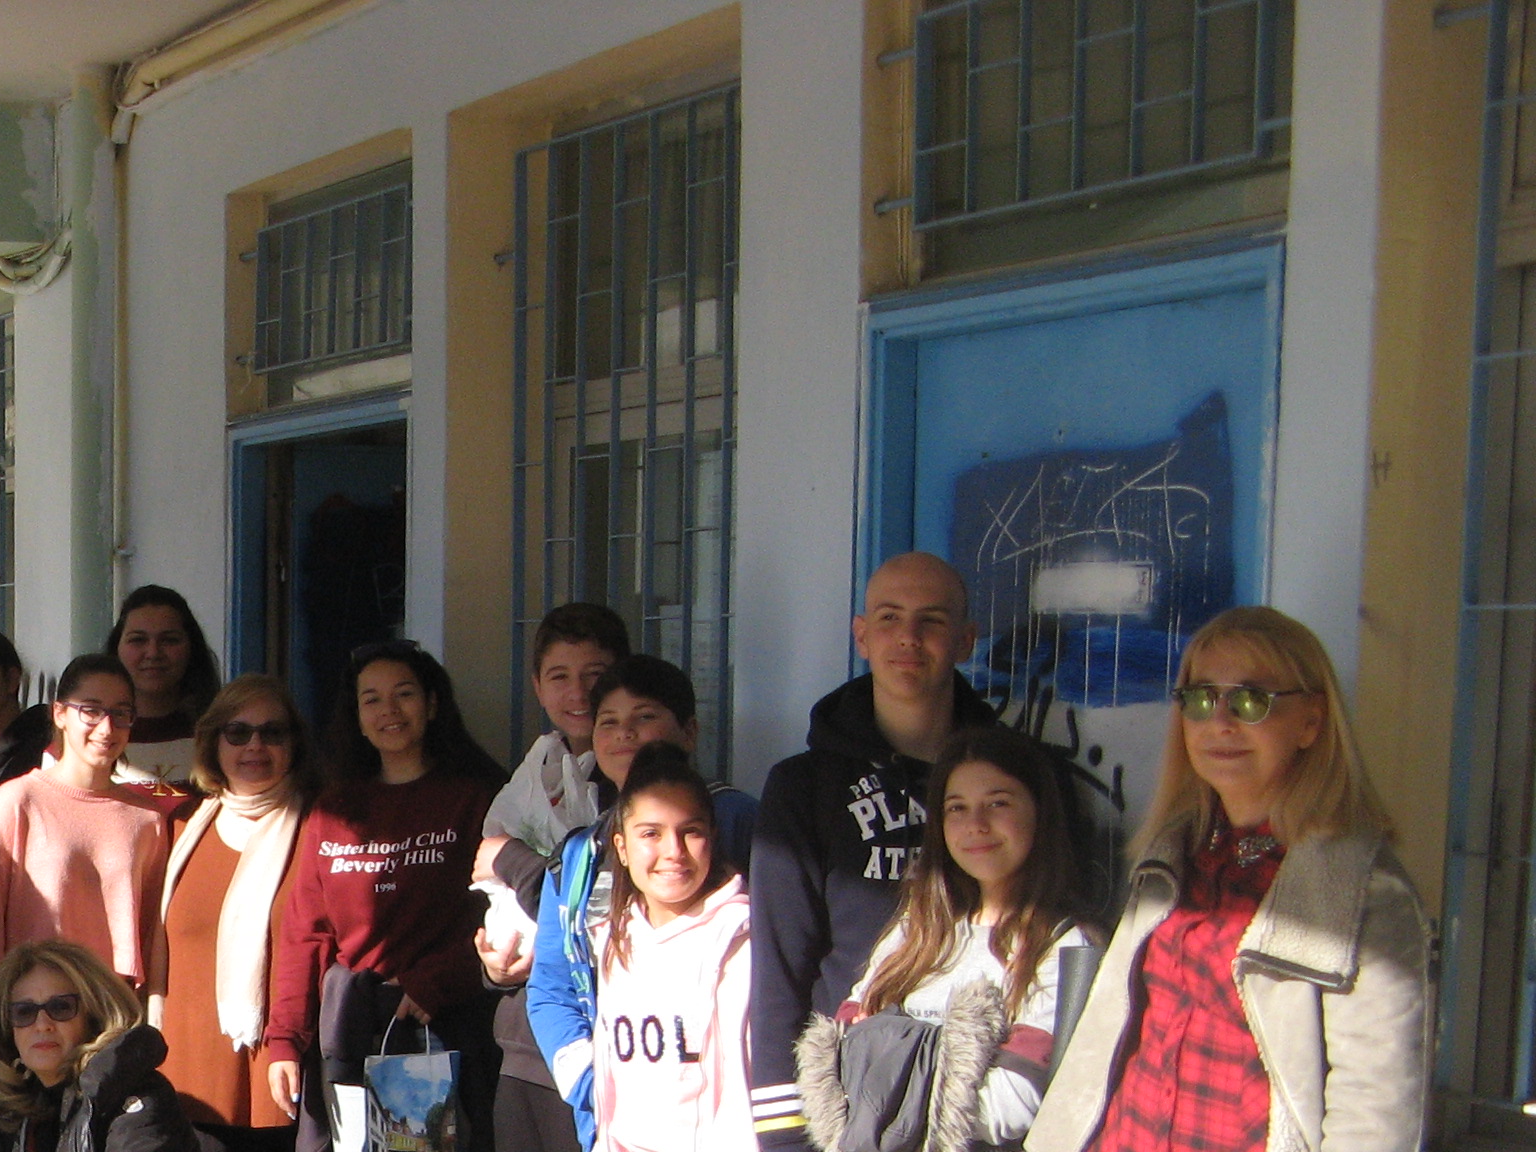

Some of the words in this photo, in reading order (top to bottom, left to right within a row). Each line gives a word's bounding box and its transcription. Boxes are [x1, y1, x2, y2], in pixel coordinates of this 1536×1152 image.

[318, 837, 411, 857] Sisterhood
[415, 828, 458, 847] Club
[330, 856, 400, 874] Beverly
[403, 848, 445, 866] Hills
[863, 845, 922, 880] AT
[602, 1013, 701, 1063] OOL
